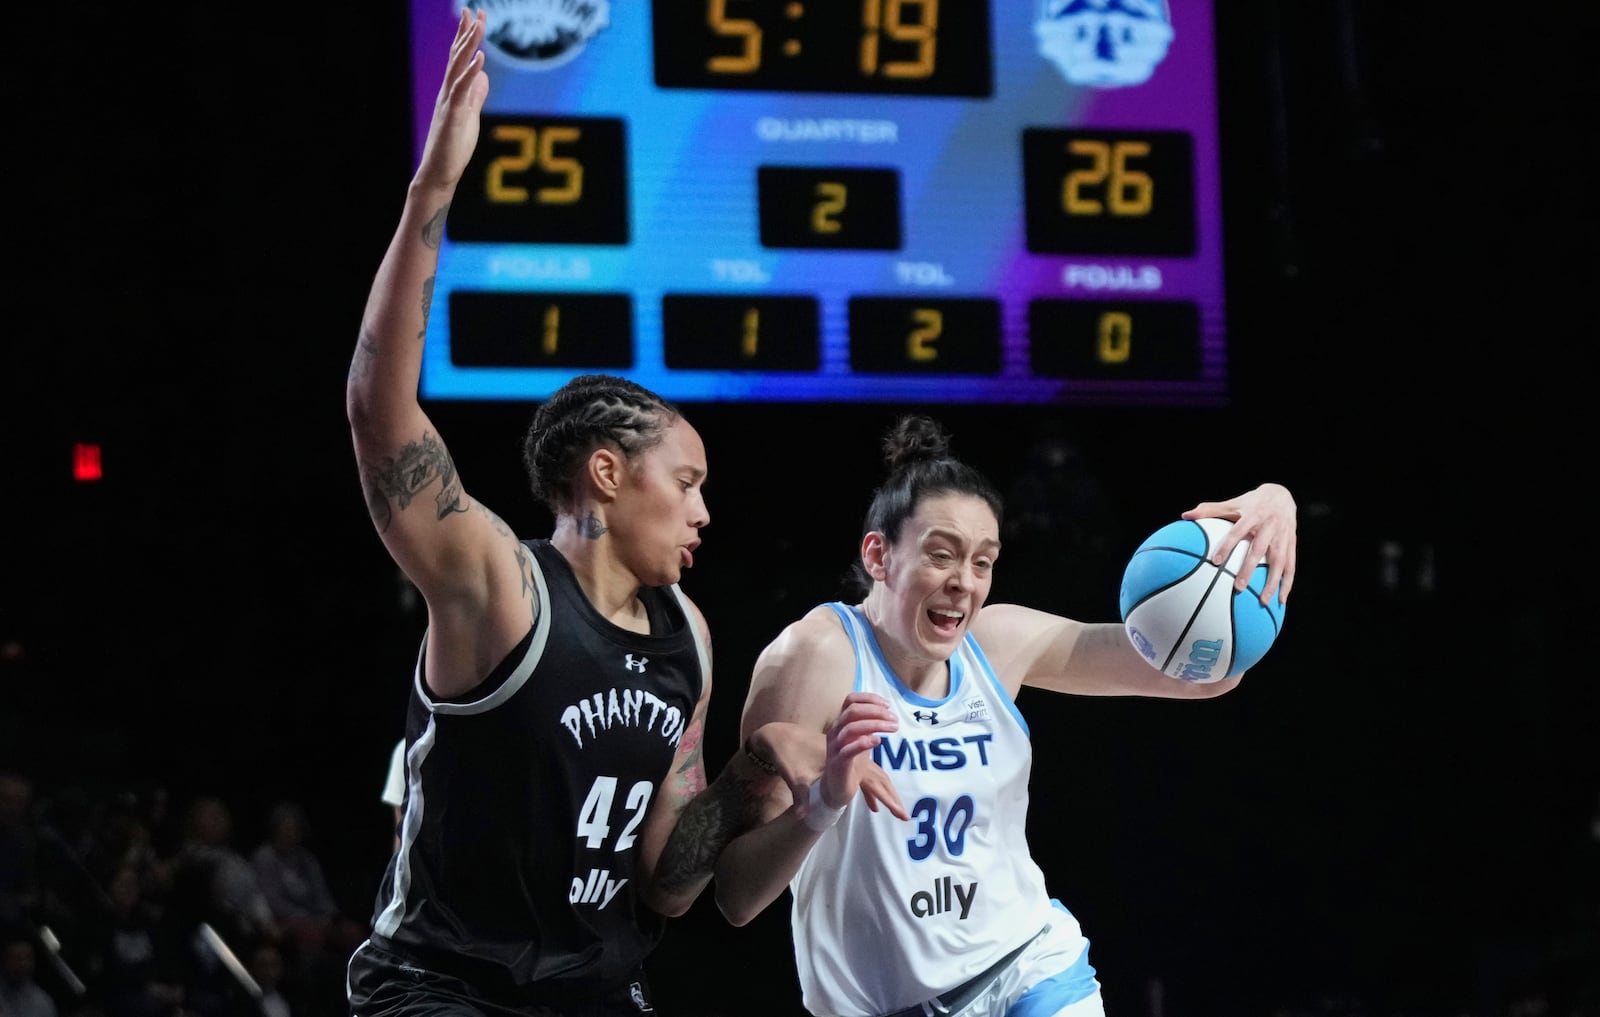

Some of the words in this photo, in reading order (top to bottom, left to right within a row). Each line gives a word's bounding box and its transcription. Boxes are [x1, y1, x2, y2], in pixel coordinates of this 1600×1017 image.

[757, 117, 899, 143] QUARTER
[486, 126, 584, 204] 25
[1062, 140, 1154, 215] 26
[811, 182, 848, 234] 2
[489, 255, 591, 280] FOULS
[1062, 264, 1164, 291] FOULS
[543, 304, 560, 355] 1
[742, 307, 760, 357] 1
[907, 309, 944, 362] 2
[1100, 311, 1133, 364] 0
[872, 732, 993, 772] MIST
[576, 775, 653, 852] 42
[906, 794, 975, 862] 30
[569, 868, 629, 911] ally
[910, 876, 978, 921] ally
